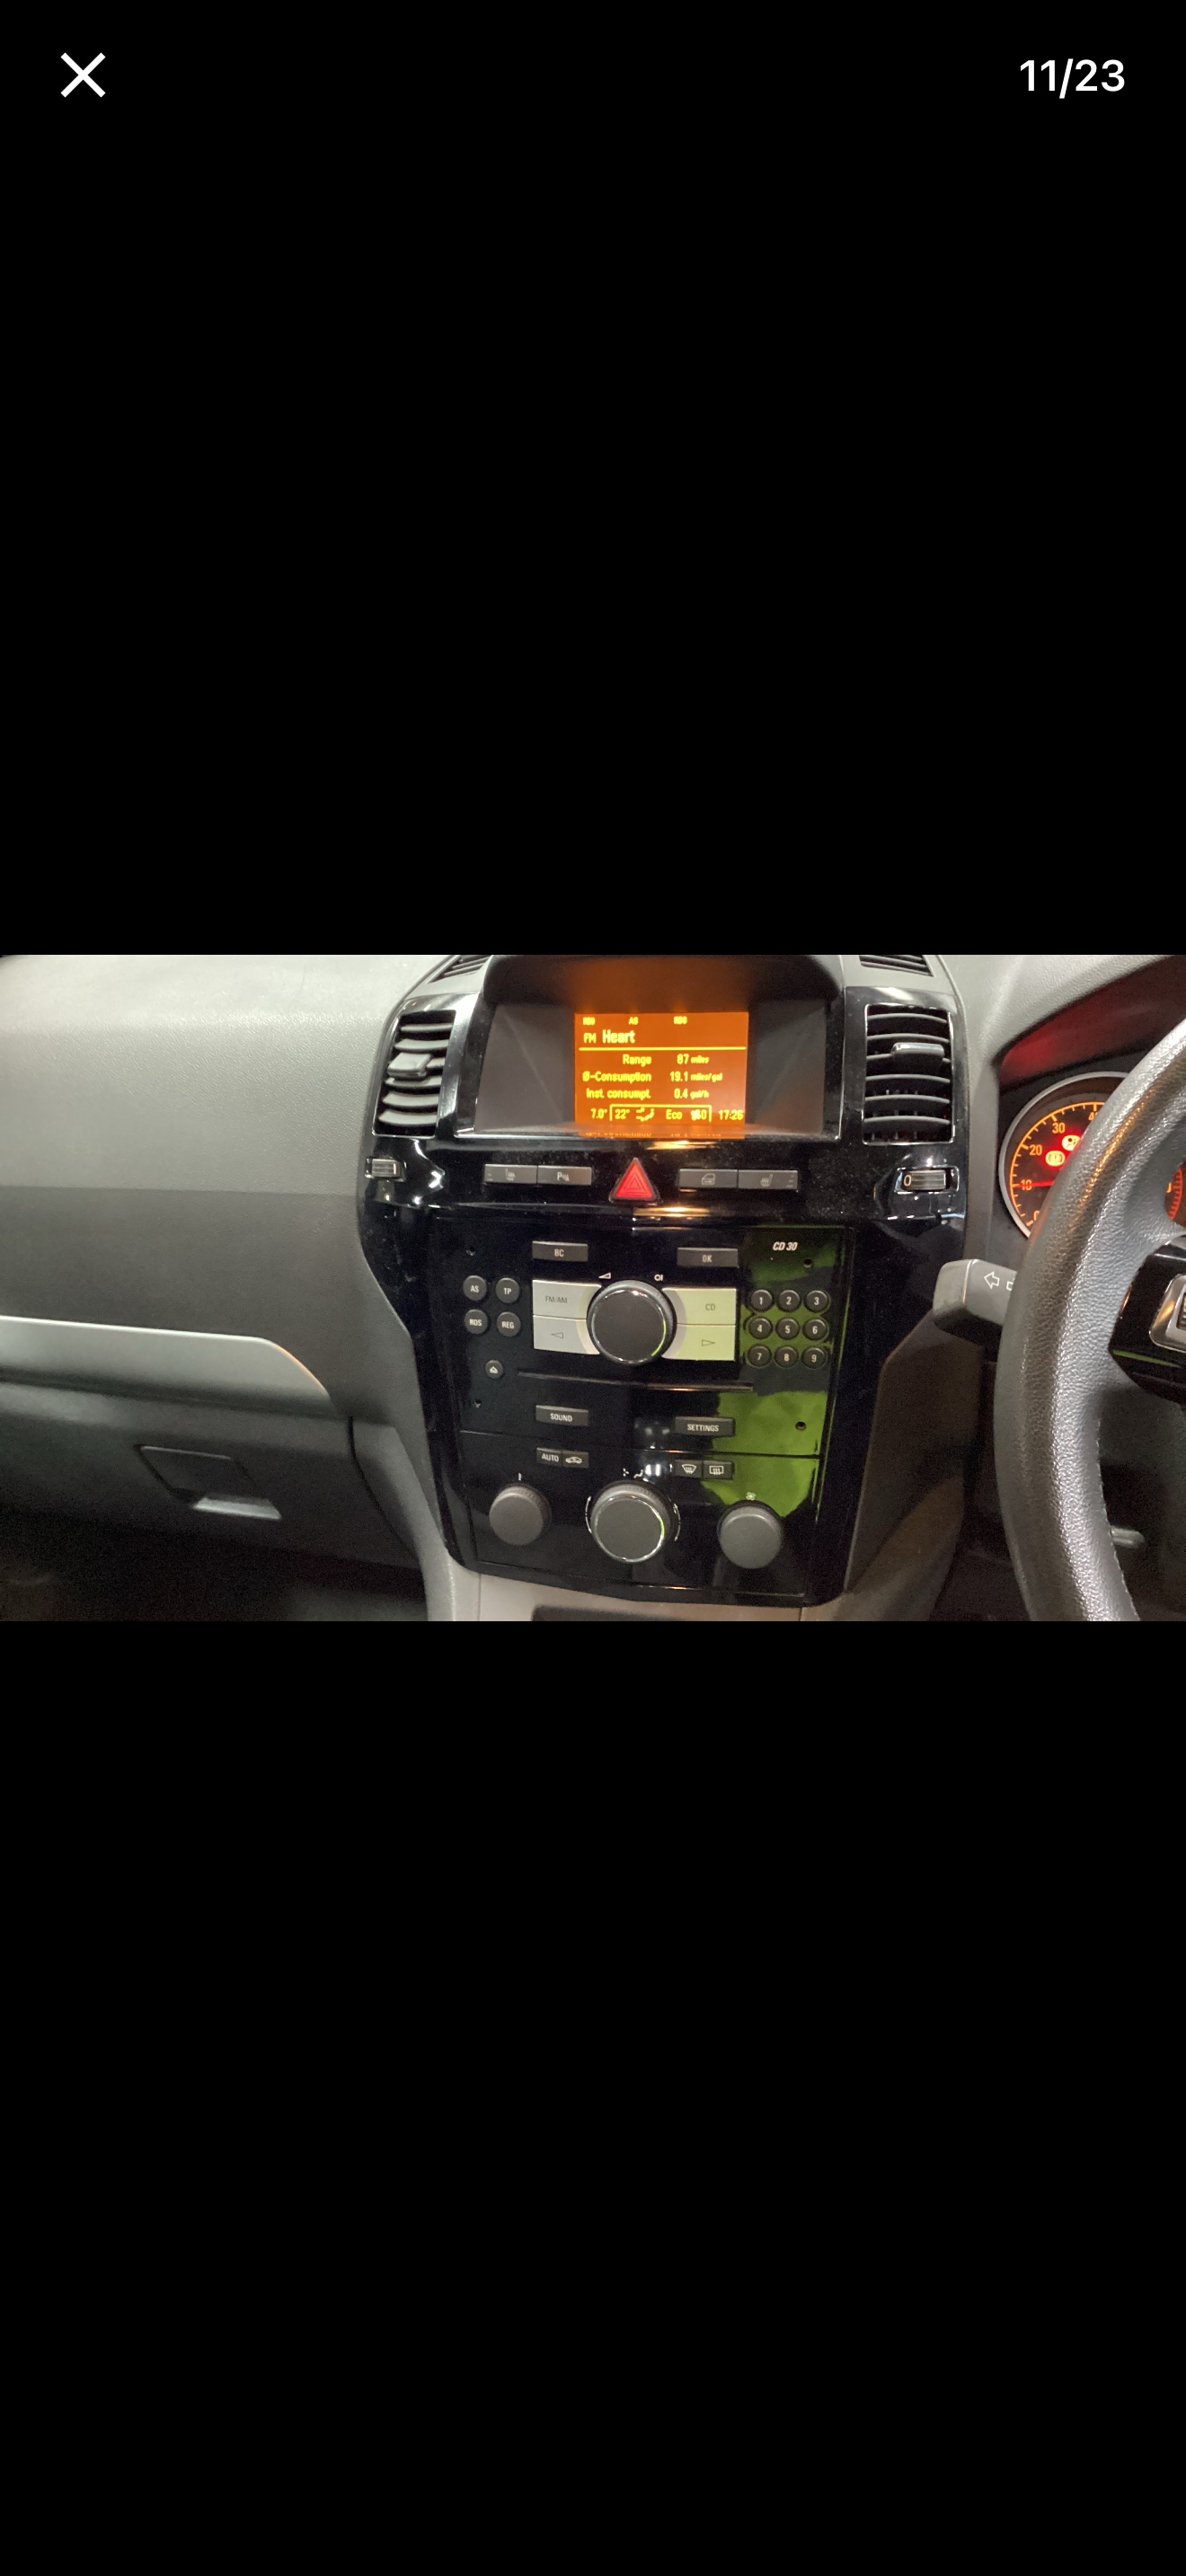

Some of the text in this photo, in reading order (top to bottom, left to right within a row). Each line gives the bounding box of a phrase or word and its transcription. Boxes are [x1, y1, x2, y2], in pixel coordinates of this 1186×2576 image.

[583, 1029, 635, 1044] FM Heart
[622, 1053, 710, 1068] Range 87 miles
[669, 1071, 688, 1082] 19.1
[690, 1072, 723, 1083] miles/gal
[586, 1088, 710, 1101] Inst. consumpt. 0.4 gal/h
[615, 1108, 630, 1120] 22°
[666, 1108, 683, 1120] Eco
[718, 1108, 744, 1121] 17:26
[1052, 1122, 1066, 1134] 30
[1029, 1144, 1042, 1156] 20
[1021, 1179, 1032, 1190] 10
[773, 1241, 798, 1251] CD 30
[553, 1248, 564, 1257] BC
[702, 1254, 712, 1263] OK
[470, 1284, 480, 1293] AS
[503, 1287, 512, 1295] TP
[544, 1295, 568, 1304] FM/AM
[786, 1296, 792, 1305] 2
[813, 1296, 819, 1306] 3
[705, 1303, 716, 1311] CD
[469, 1319, 482, 1327] RDS
[501, 1320, 515, 1329] REG
[757, 1324, 763, 1333] 4
[784, 1325, 791, 1334] 5
[812, 1325, 819, 1335] 6
[783, 1353, 790, 1362] 8
[811, 1354, 817, 1363] 9
[550, 1413, 573, 1423] SOUND
[686, 1424, 720, 1433] SETTINGS
[541, 1452, 560, 1463] AUTO
